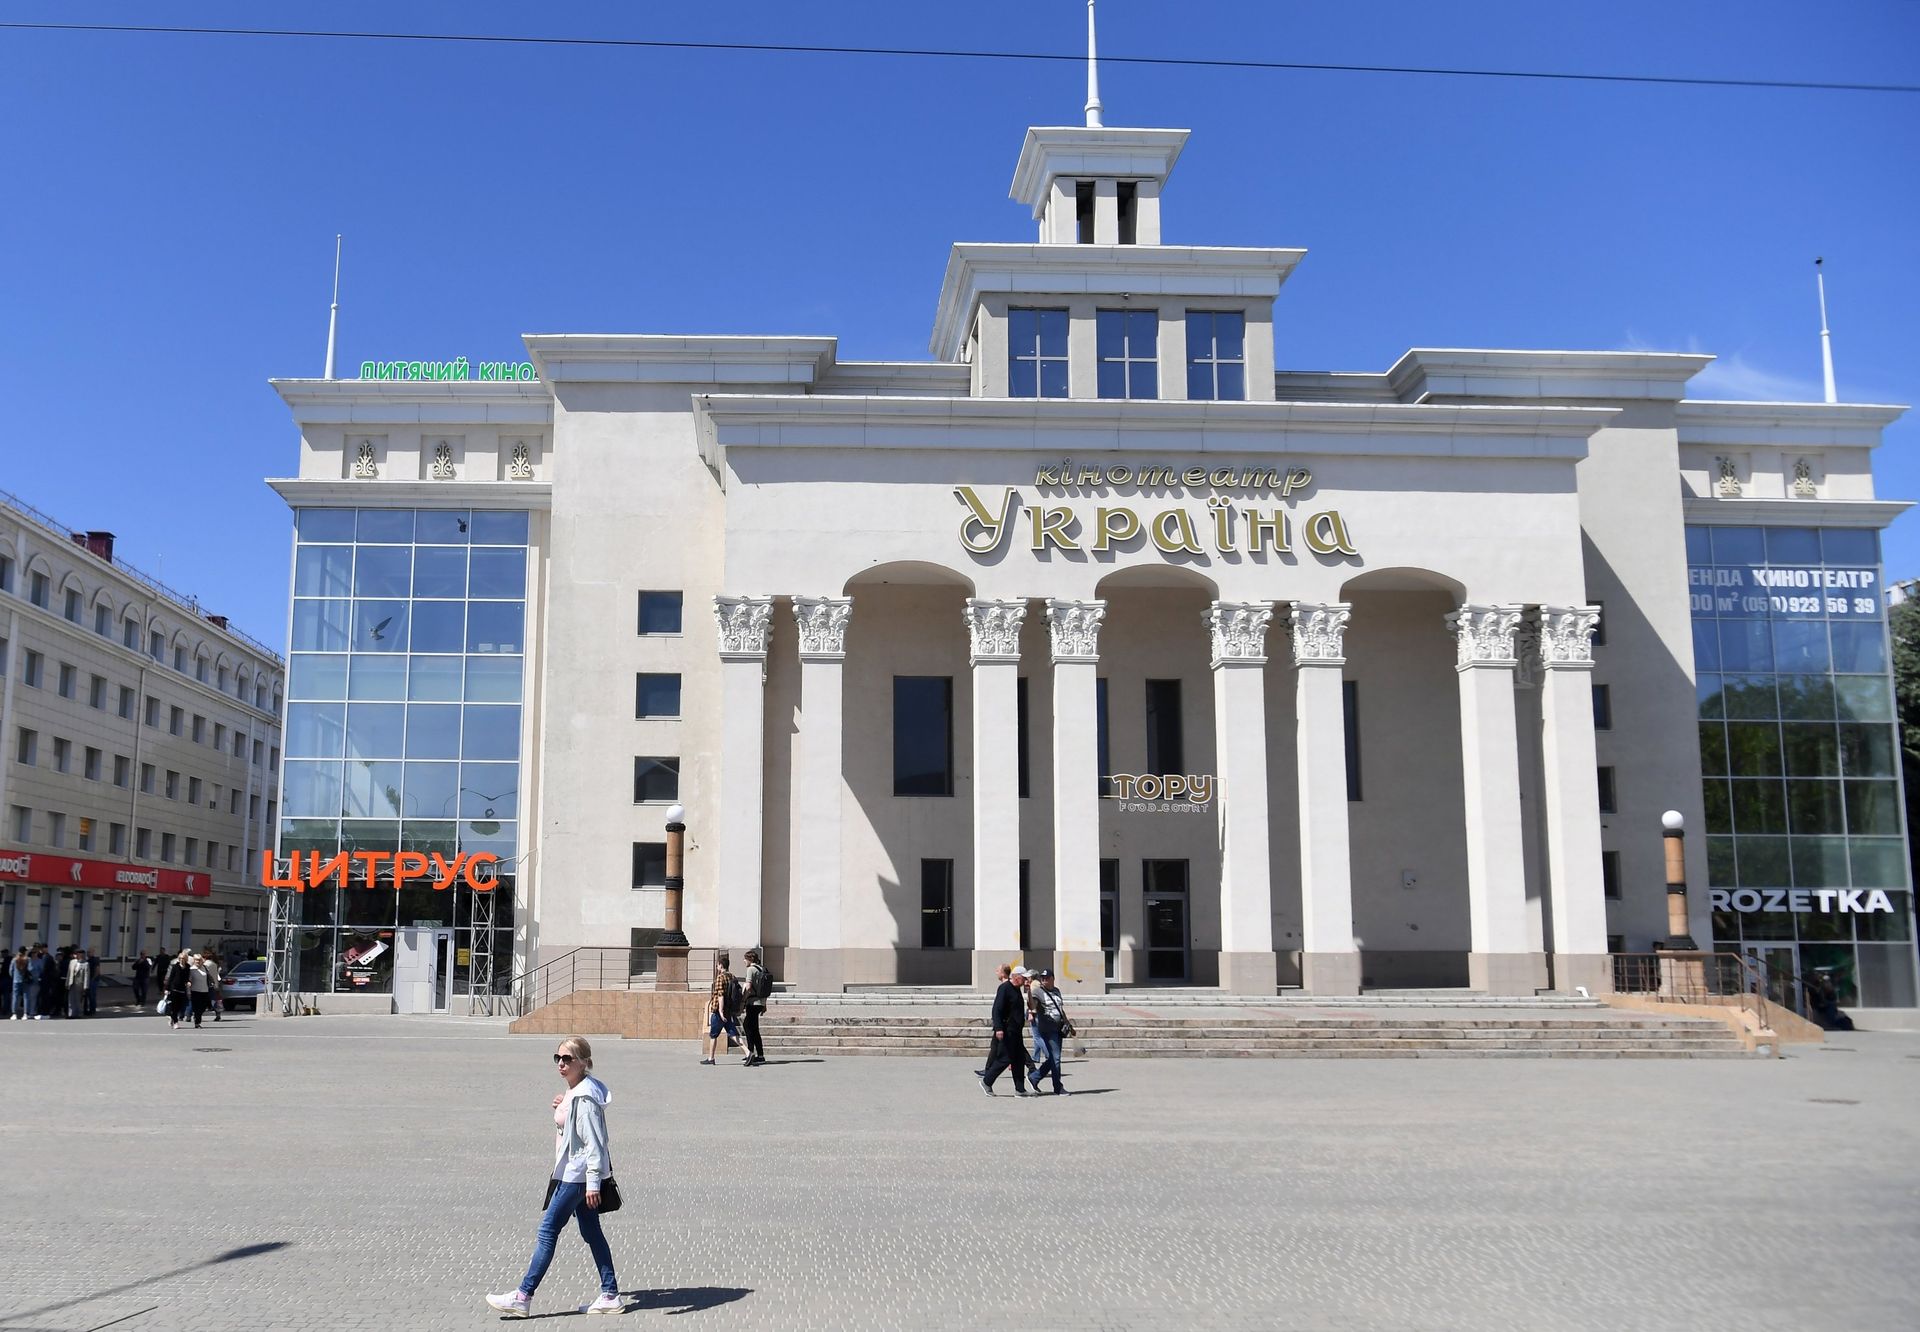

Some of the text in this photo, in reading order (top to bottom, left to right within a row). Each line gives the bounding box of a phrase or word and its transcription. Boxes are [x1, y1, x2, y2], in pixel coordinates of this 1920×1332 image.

[1034, 456, 1313, 498] кінотеатр
[952, 485, 1358, 556] Україна
[1752, 569, 1875, 588] КИНОТЕАТР
[1827, 597, 1848, 613] 56
[1854, 598, 1875, 614] 39
[262, 849, 500, 893] ЦИТРУС
[1709, 889, 1894, 914] ROZETKA
